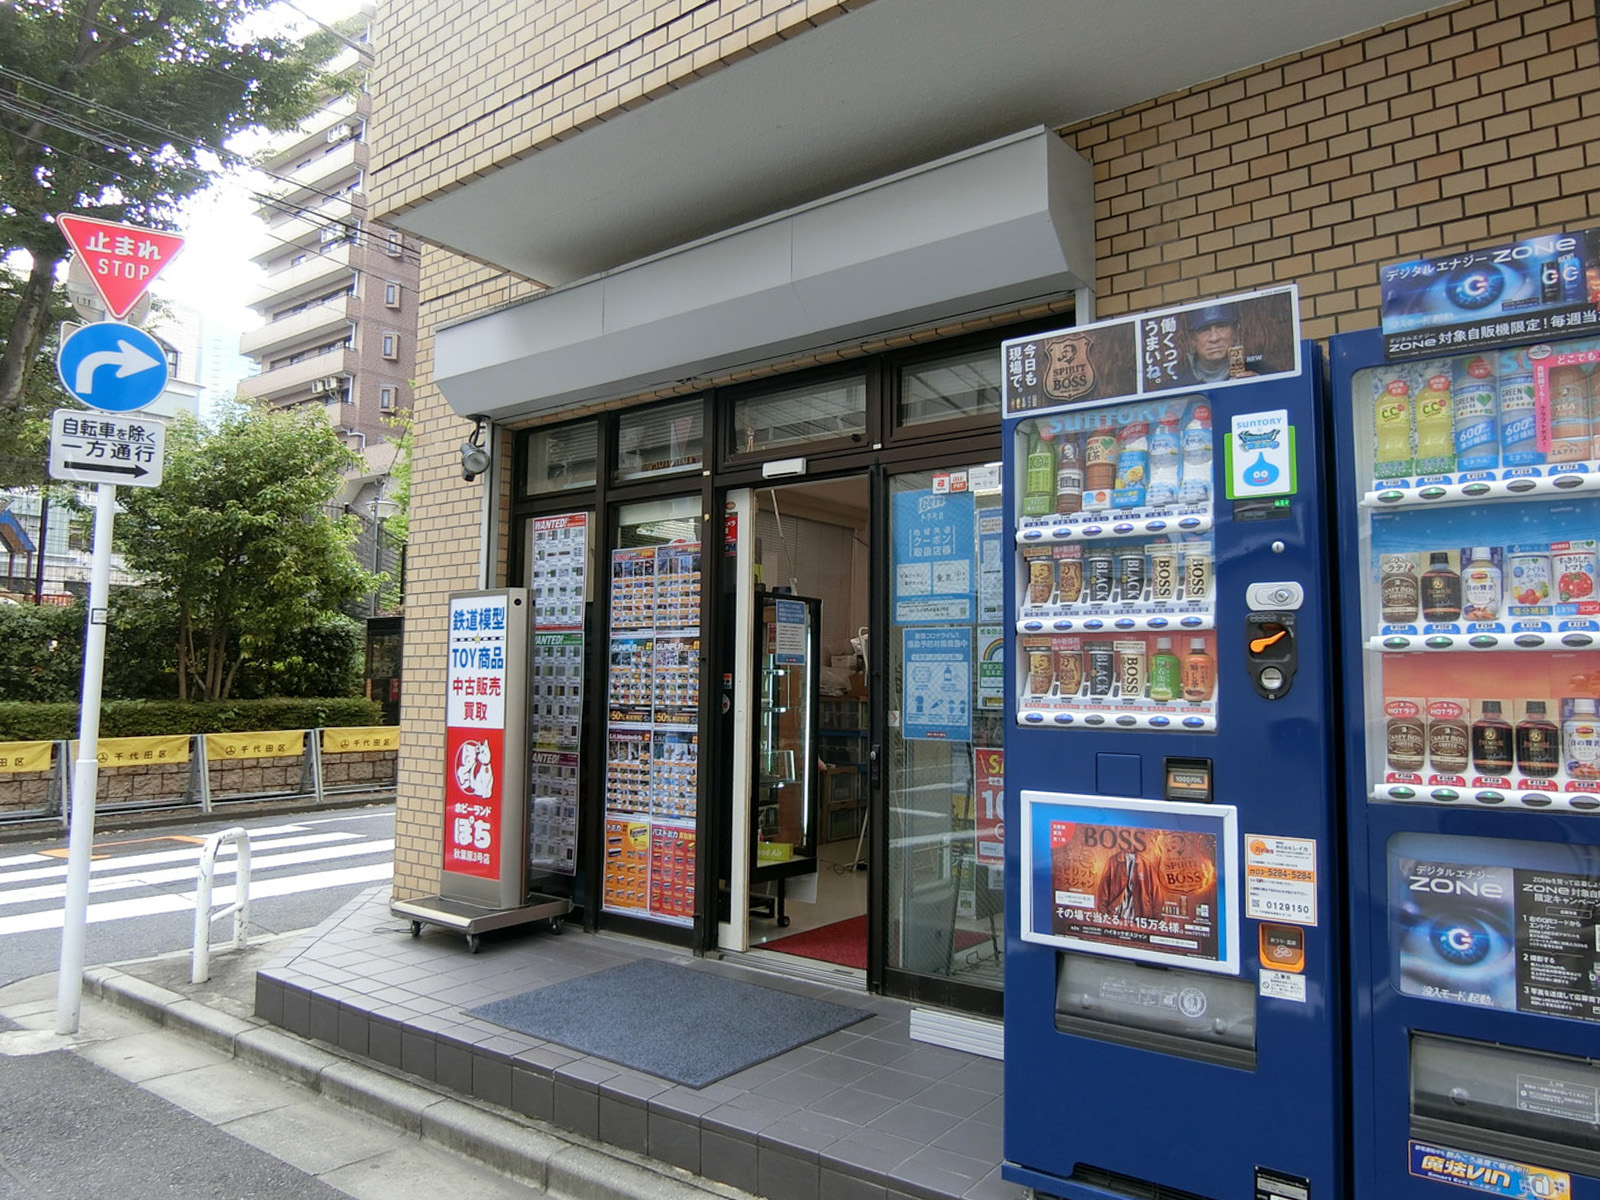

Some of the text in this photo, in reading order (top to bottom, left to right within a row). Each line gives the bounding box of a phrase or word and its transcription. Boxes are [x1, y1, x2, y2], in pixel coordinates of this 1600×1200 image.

[86, 231, 161, 260] 止まれ
[97, 258, 150, 280] STOP
[1386, 255, 1488, 282] デジタルエナジー
[1145, 320, 1162, 385] うまいね。
[1160, 317, 1178, 381] 働くって、
[1557, 353, 1596, 365] どこでも
[1009, 346, 1025, 394] 現場で。
[1024, 343, 1037, 387] 今日も
[1052, 364, 1086, 377] SPIRIT
[1053, 374, 1088, 389] BOSS
[62, 418, 156, 444] 自転車を除く
[61, 440, 155, 463] 一方通行
[534, 517, 568, 531] WANTED!
[913, 535, 951, 547] クーポン
[1558, 556, 1590, 564] すっきりした
[1564, 564, 1585, 572] トマト
[1096, 561, 1110, 602] BLACK
[1127, 559, 1140, 600] BLACK
[1158, 559, 1171, 596] BOSS
[1191, 558, 1205, 596] BOSS
[453, 605, 505, 632] 鉄道模型
[452, 645, 504, 670] TOY商品
[1096, 654, 1109, 693] BLACK
[1126, 657, 1139, 693] BOSS
[452, 676, 502, 697] 中古販売
[463, 701, 488, 722] 買取
[241, 743, 286, 754] 千代田区
[353, 738, 391, 748] 千代田区
[114, 749, 167, 761] 千代田区
[454, 803, 492, 818] ホビーランド
[454, 815, 491, 850] ぽち
[1082, 826, 1148, 853] BOSS
[453, 849, 491, 866] 秋葉原3号店
[1166, 872, 1203, 885] BOSS
[1256, 868, 1312, 880] 03-5284-5284
[1415, 865, 1497, 879] デジタルエナジー
[1266, 901, 1309, 914] 0129150
[1522, 914, 1528, 922] 1
[1523, 954, 1529, 962] 2
[1523, 986, 1529, 994] 3
[1427, 1171, 1452, 1182] Smart
[1453, 1176, 1468, 1185] Eco
